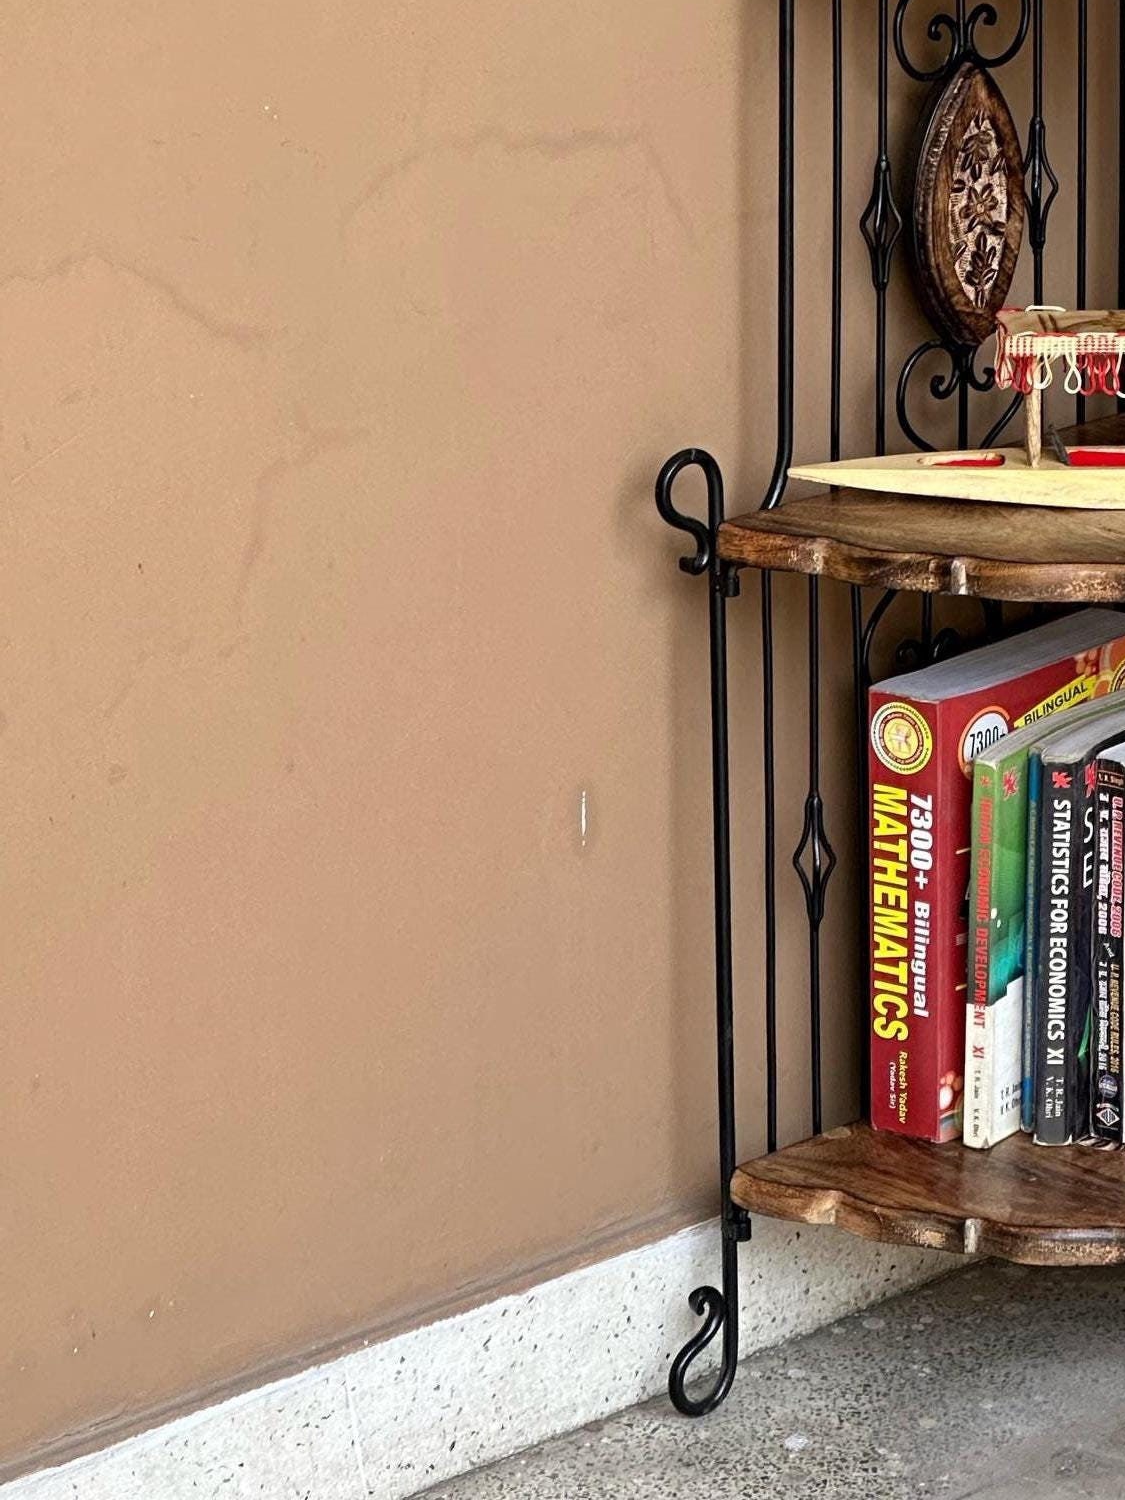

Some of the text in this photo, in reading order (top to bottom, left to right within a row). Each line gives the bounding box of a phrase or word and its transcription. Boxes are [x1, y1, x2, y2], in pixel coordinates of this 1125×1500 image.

[1024, 681, 1088, 726] BILINGUAL
[1111, 820, 1123, 871] REVENUE
[873, 783, 908, 1041] MATHEMATICS
[910, 794, 933, 1018] 7300+ Bilingual
[1110, 905, 1123, 938] 2006
[1046, 799, 1072, 1065] STATISTICS FOR ECONOMICS XI
[974, 928, 989, 1028] DEVELOPMENT
[1110, 979, 1120, 1012] REVENUE
[1110, 1012, 1120, 1031] CODE
[972, 1045, 985, 1059] XI
[898, 1051, 908, 1124] Rakesh Yadav
[1045, 1097, 1054, 1119] Ohri
[1055, 1097, 1064, 1117] Jain
